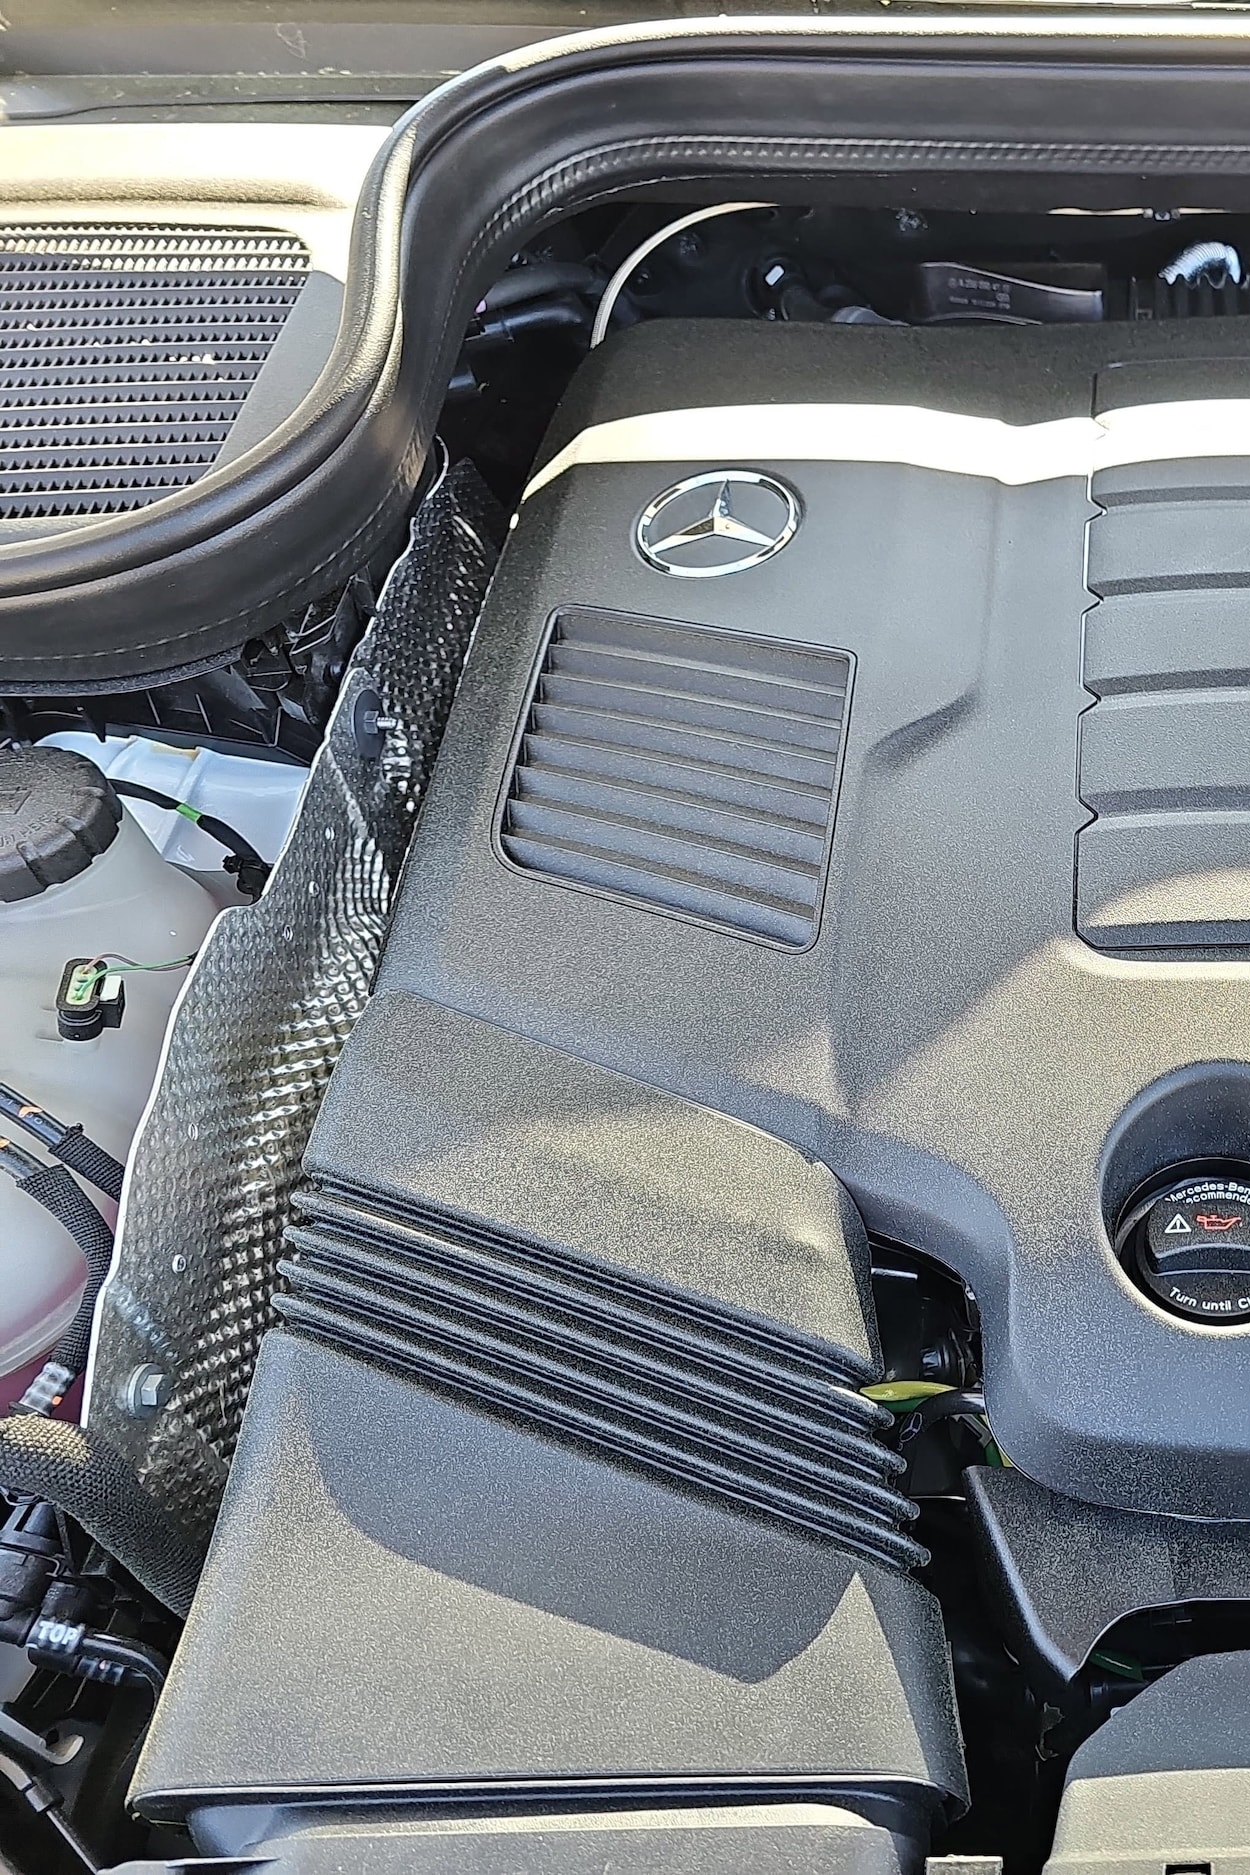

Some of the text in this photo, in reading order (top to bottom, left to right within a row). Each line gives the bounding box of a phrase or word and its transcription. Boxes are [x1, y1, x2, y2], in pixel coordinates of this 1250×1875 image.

[1169, 1286, 1198, 1307] Turn
[1202, 1300, 1232, 1311] until
[37, 1620, 80, 1646] TOP
